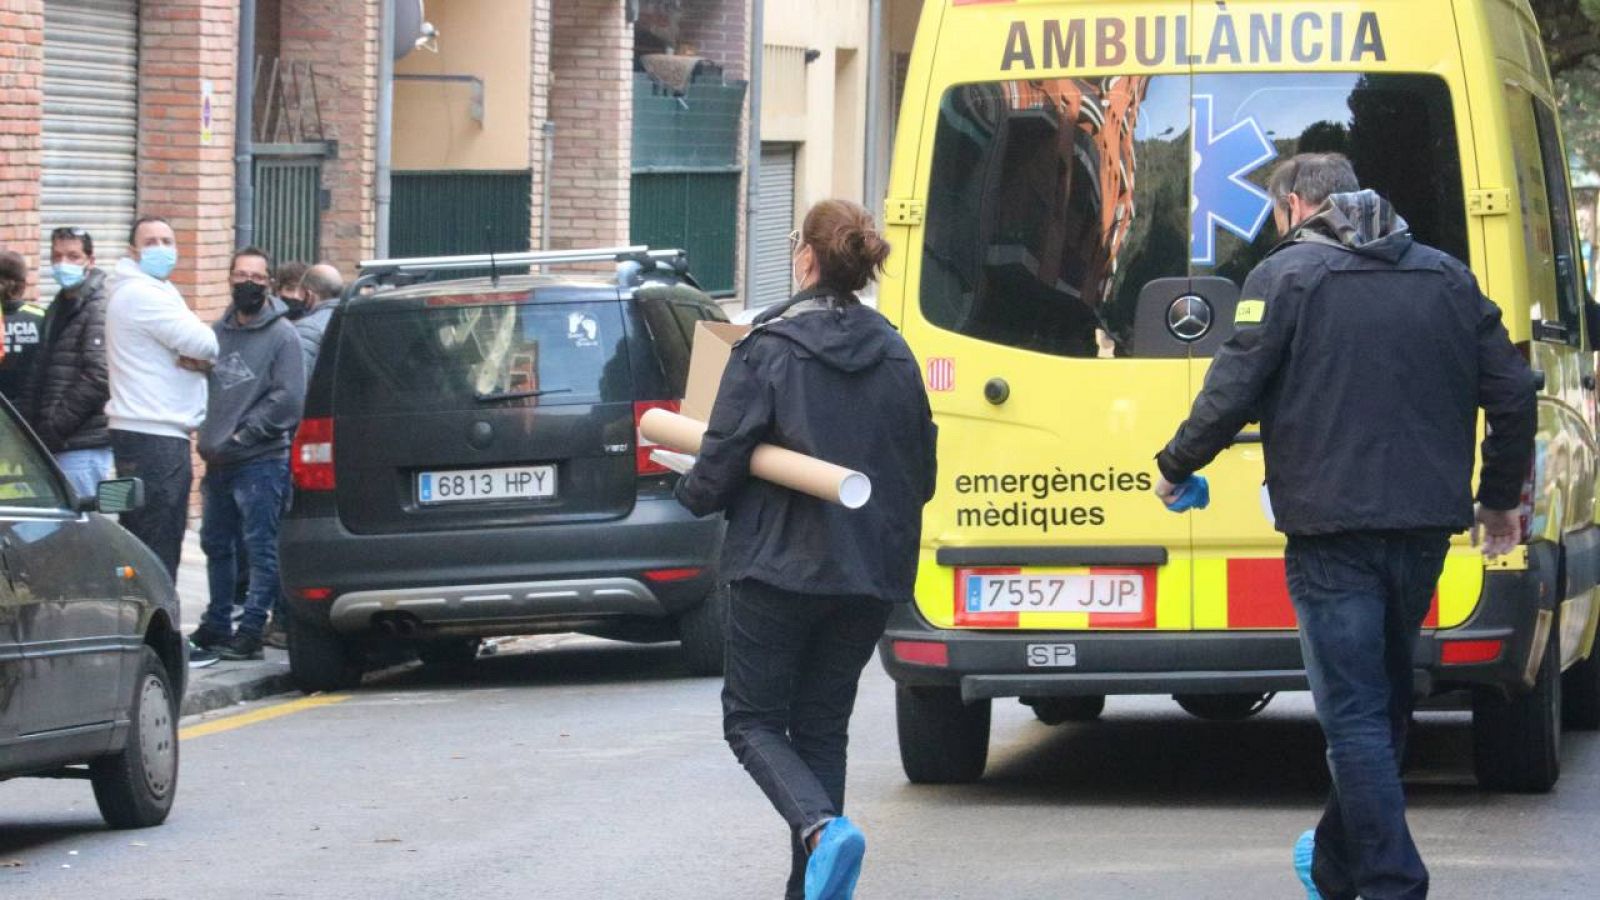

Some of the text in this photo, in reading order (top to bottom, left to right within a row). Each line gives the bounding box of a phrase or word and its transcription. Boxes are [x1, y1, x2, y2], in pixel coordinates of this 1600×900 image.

[1000, 2, 1387, 71] AMBULÀNCIA
[438, 470, 546, 497] 6813 HPY
[954, 465, 1152, 499] emergències
[955, 501, 1106, 532] mèdiques
[988, 578, 1137, 608] 7557 JJP
[1030, 645, 1073, 666] SP
